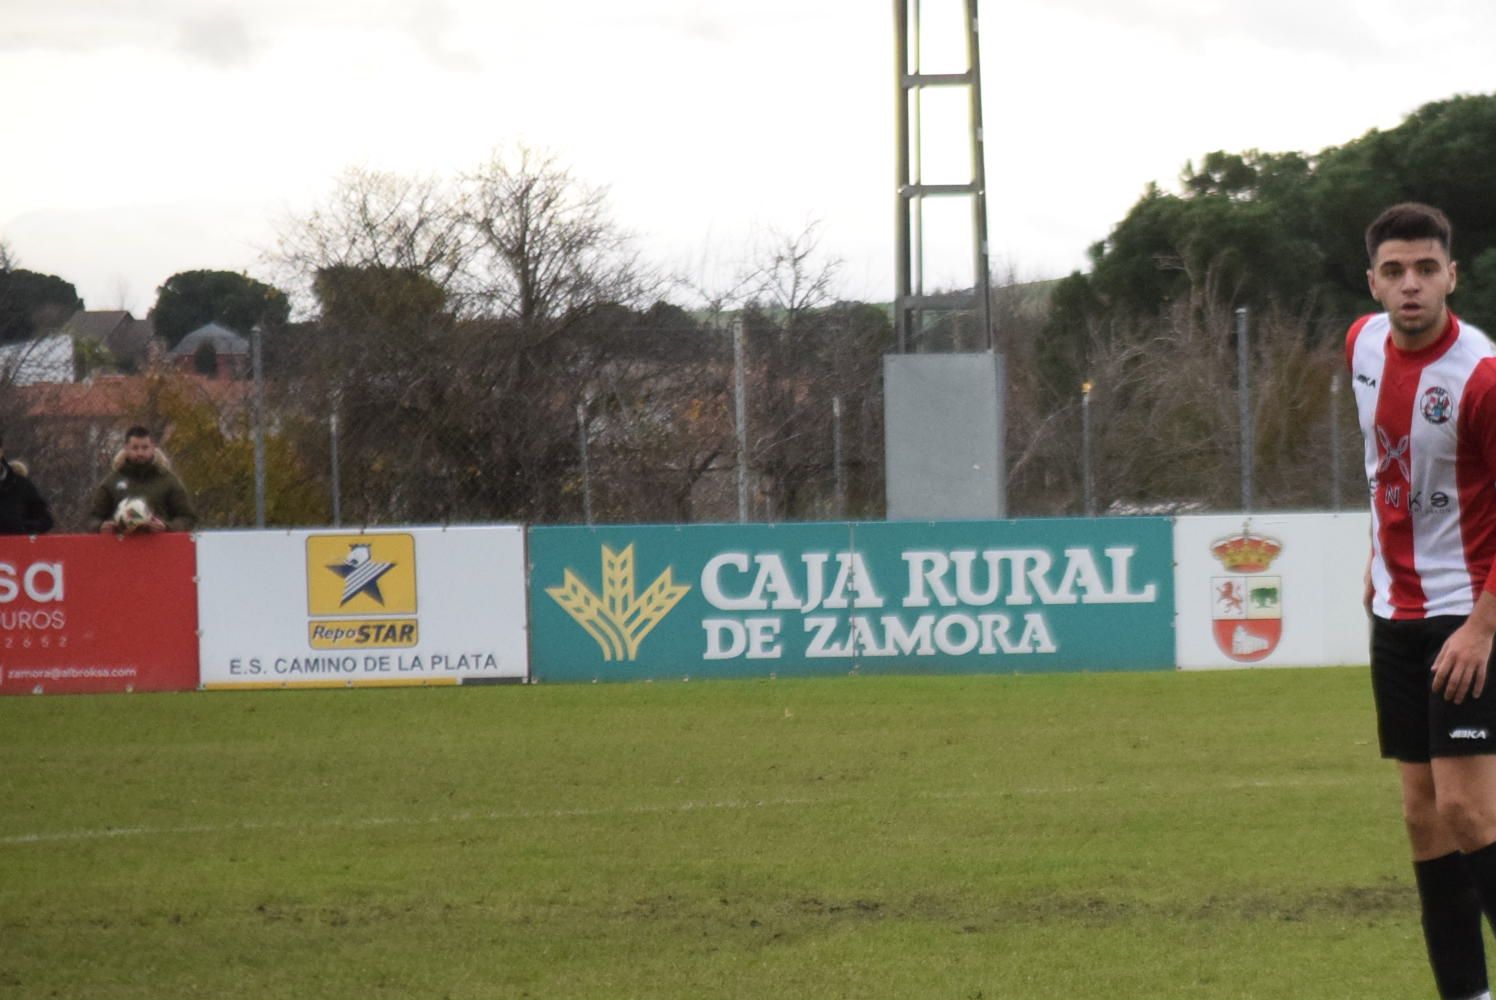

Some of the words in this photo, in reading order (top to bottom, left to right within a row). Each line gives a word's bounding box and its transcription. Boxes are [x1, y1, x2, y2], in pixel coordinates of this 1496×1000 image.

[700, 551, 883, 613] CAJA
[901, 547, 1156, 608] RURAL
[703, 618, 783, 660] DE
[804, 613, 1058, 659] ZAMORA
[229, 658, 267, 675] E.S.
[274, 656, 357, 674] CAMINO
[364, 655, 390, 673] DE
[397, 655, 424, 672] LA
[431, 654, 498, 671] PLATA
